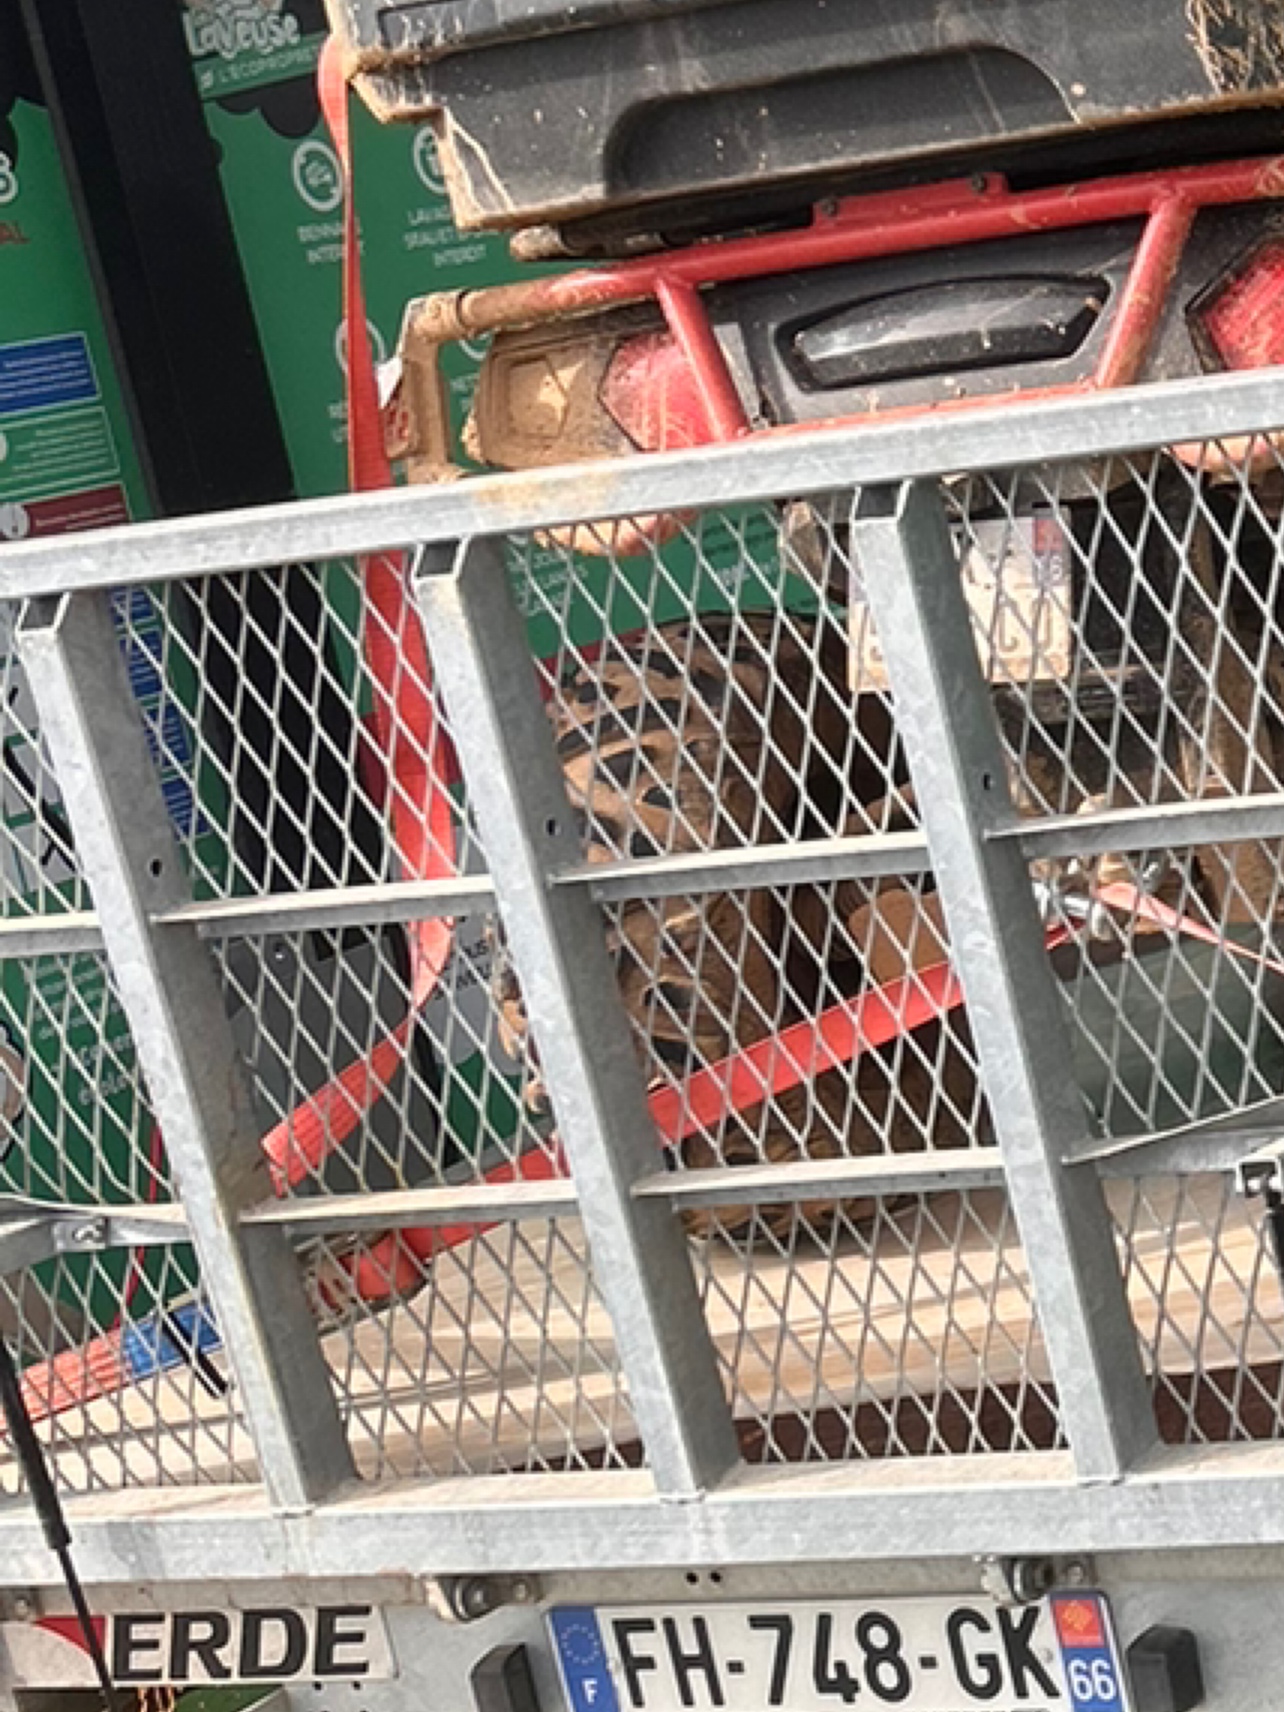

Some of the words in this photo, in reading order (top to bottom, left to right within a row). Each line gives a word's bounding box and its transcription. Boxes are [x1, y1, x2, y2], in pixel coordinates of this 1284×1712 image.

[113, 1605, 372, 1681] ERDE
[612, 1606, 1061, 1708] FH-748-GK
[585, 1679, 599, 1704] F
[1068, 1658, 1115, 1703] 66
